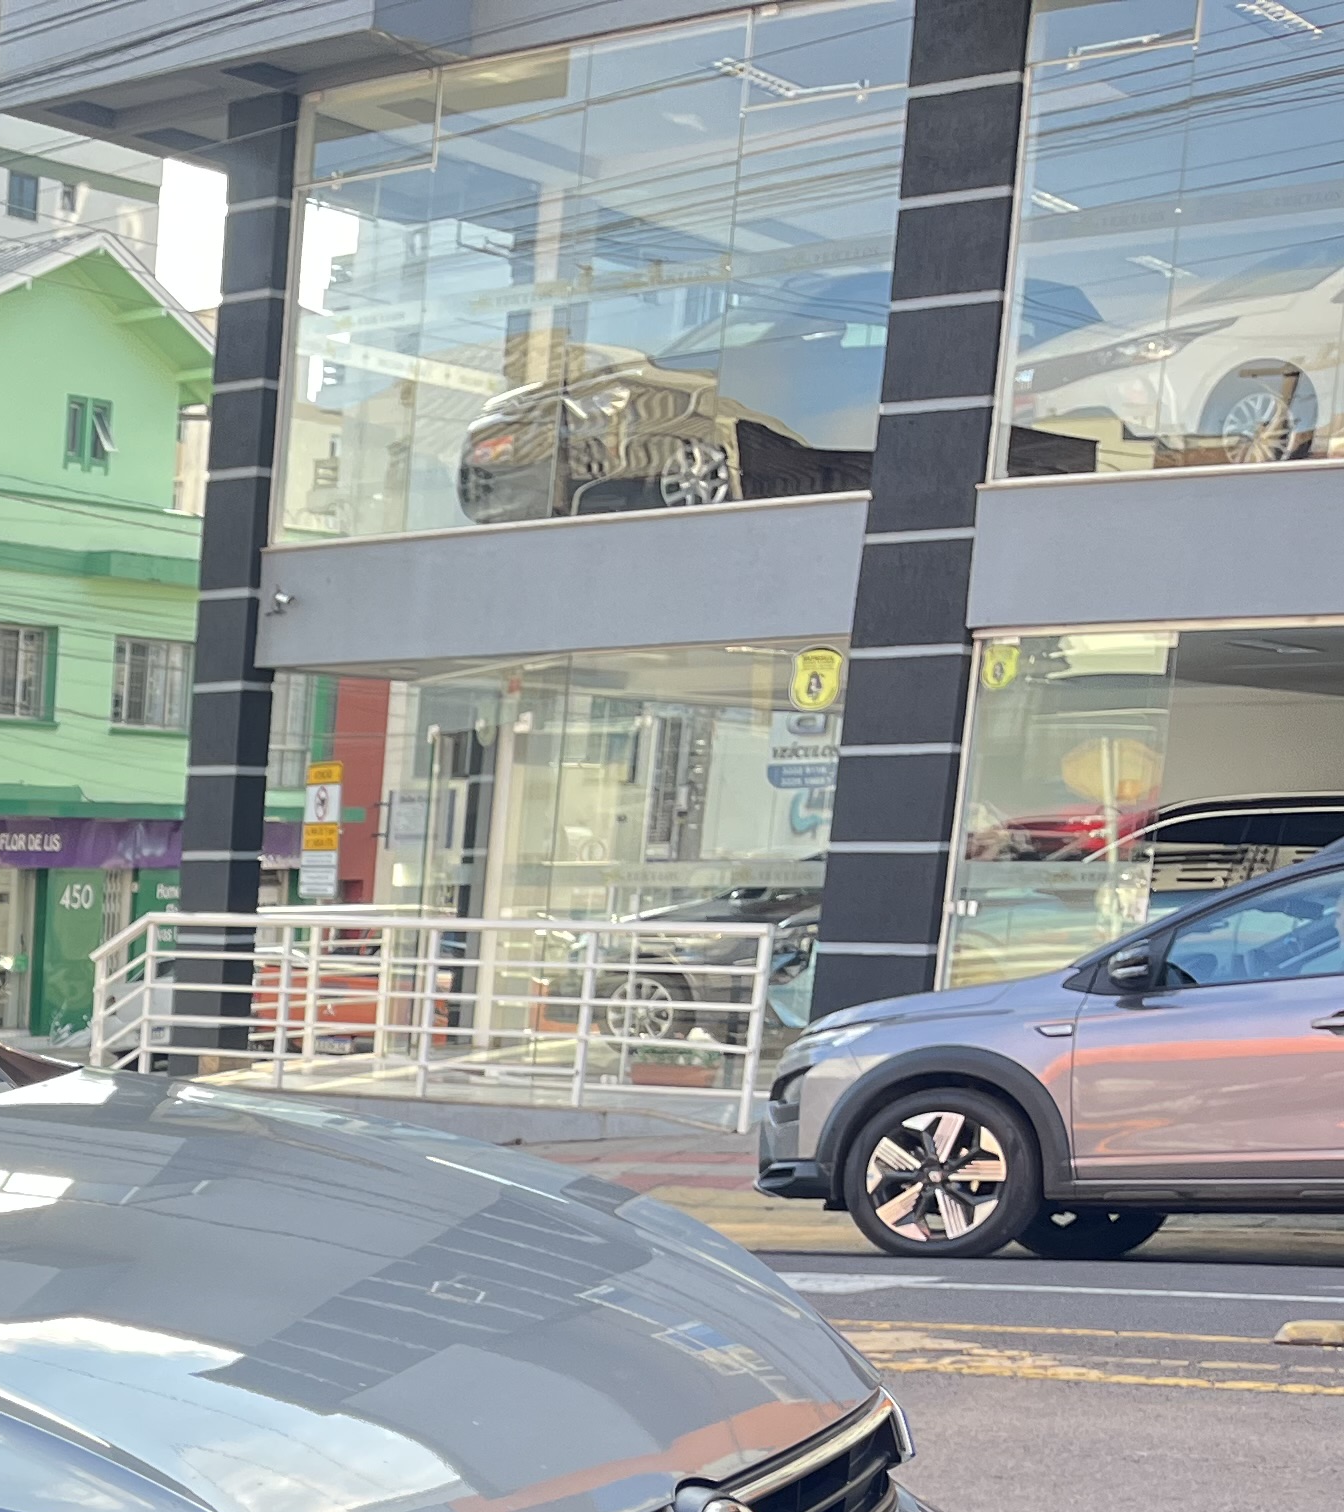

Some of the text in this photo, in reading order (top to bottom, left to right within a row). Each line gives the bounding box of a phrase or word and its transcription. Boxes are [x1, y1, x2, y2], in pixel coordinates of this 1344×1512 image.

[0, 832, 27, 852] FLOR
[27, 832, 43, 851] DE
[43, 833, 62, 853] LIS
[58, 883, 94, 910] 450
